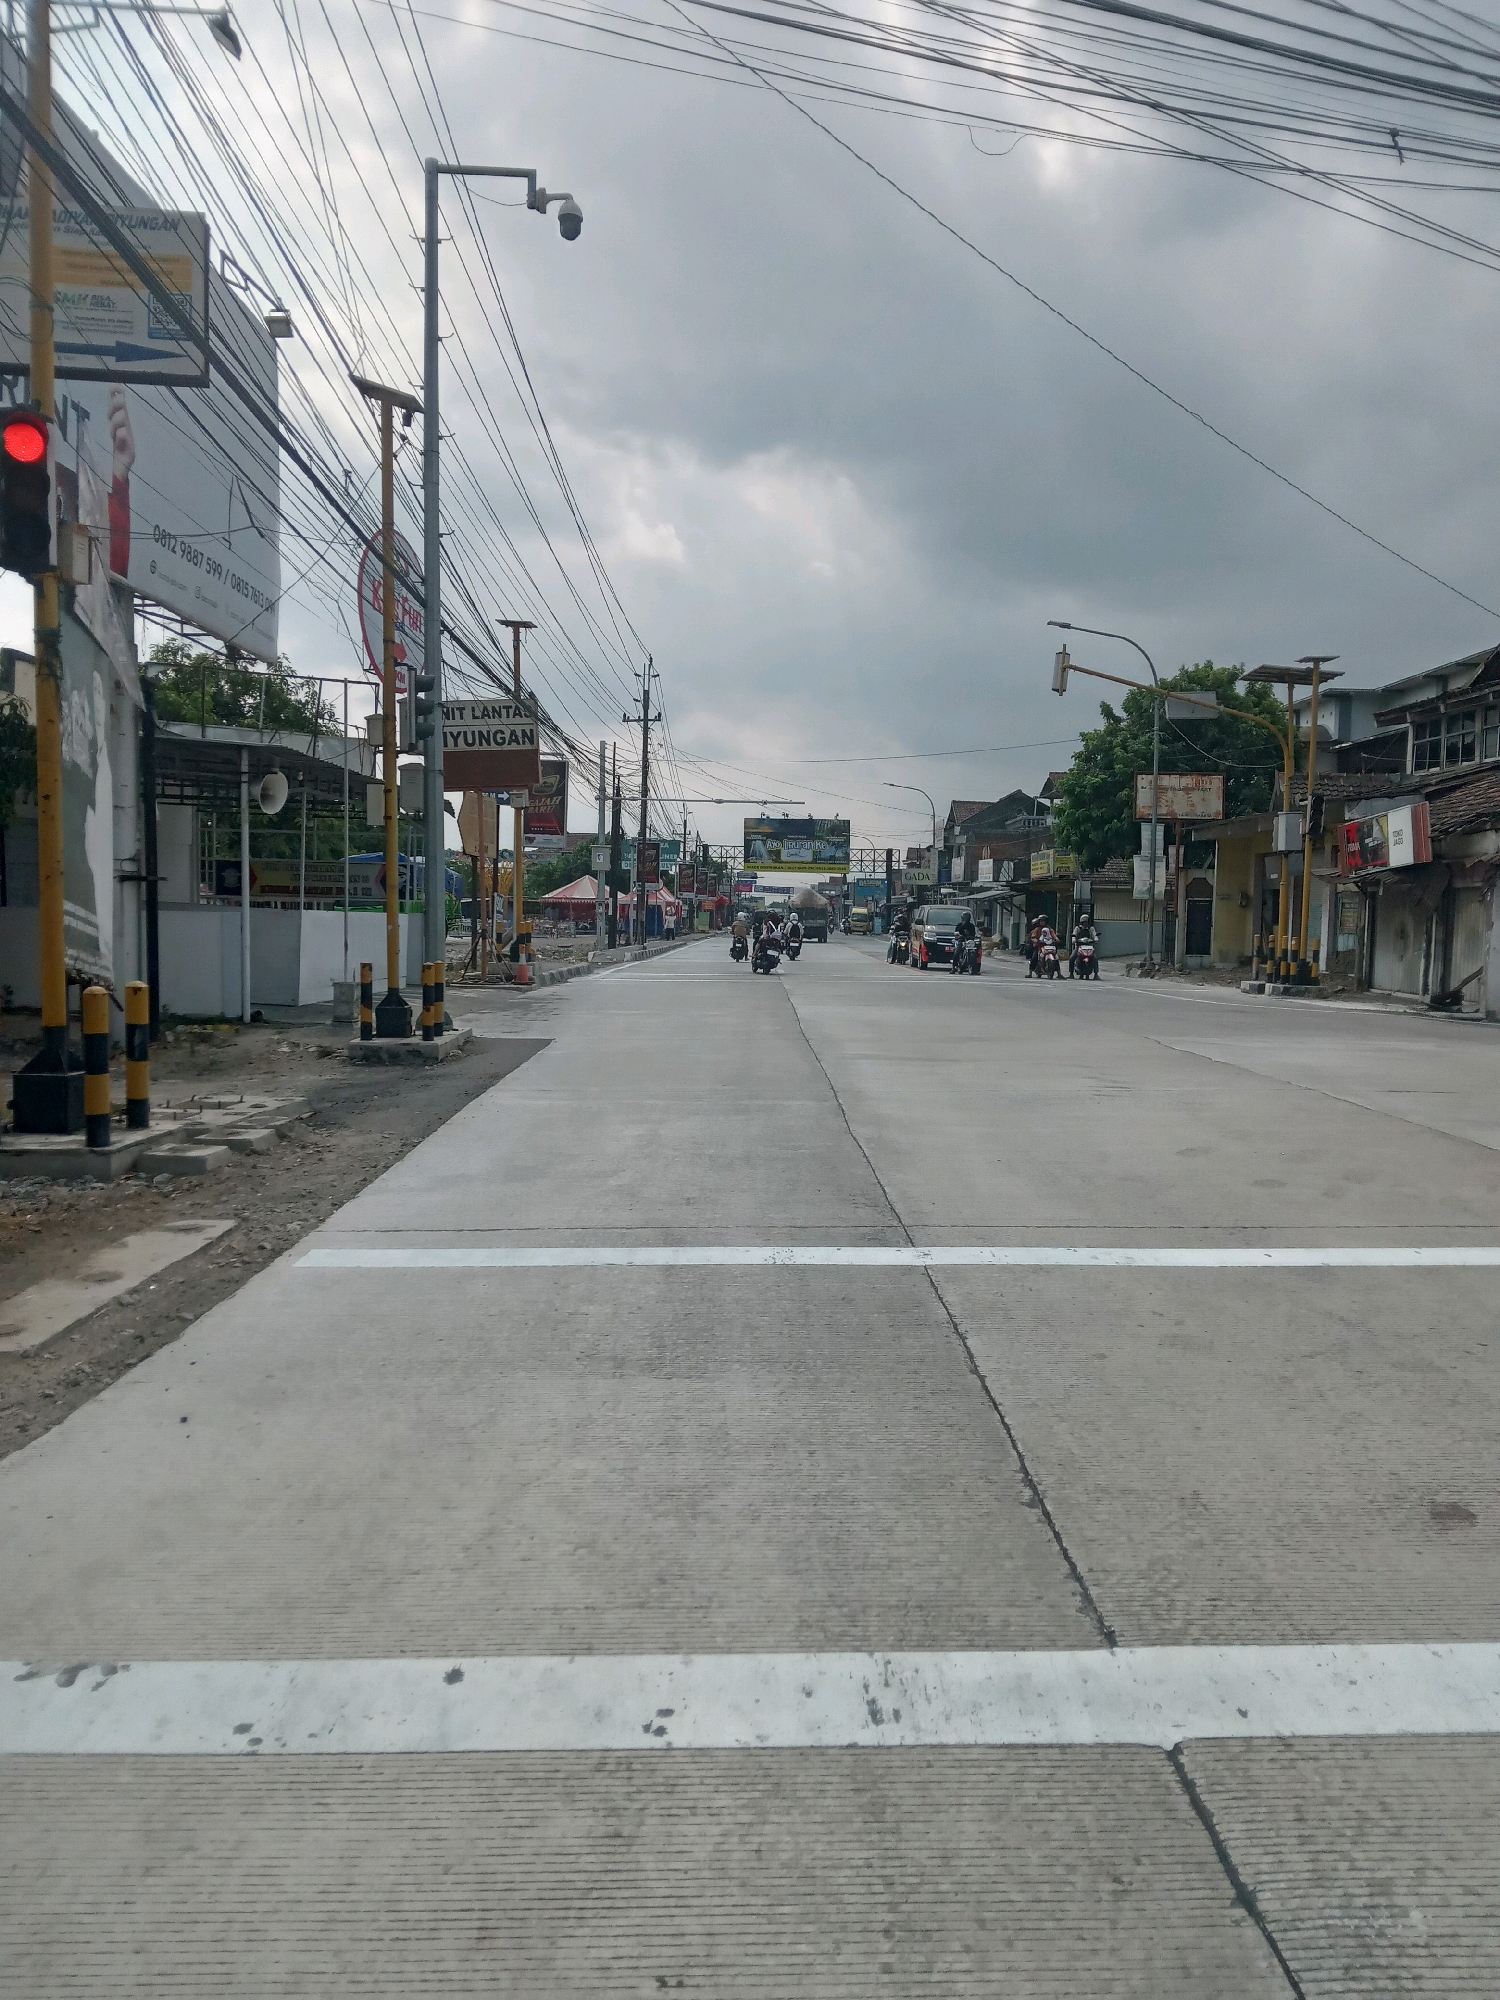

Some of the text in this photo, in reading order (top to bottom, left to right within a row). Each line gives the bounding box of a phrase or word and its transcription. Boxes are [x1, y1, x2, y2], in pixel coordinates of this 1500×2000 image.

[153, 525, 177, 555] 0812
[180, 541, 204, 569] 9887
[205, 556, 223, 581] 599
[231, 573, 249, 599] 0815
[441, 706, 466, 721] NIT
[443, 728, 535, 748] IYUNGAN
[904, 871, 931, 882] GADA
